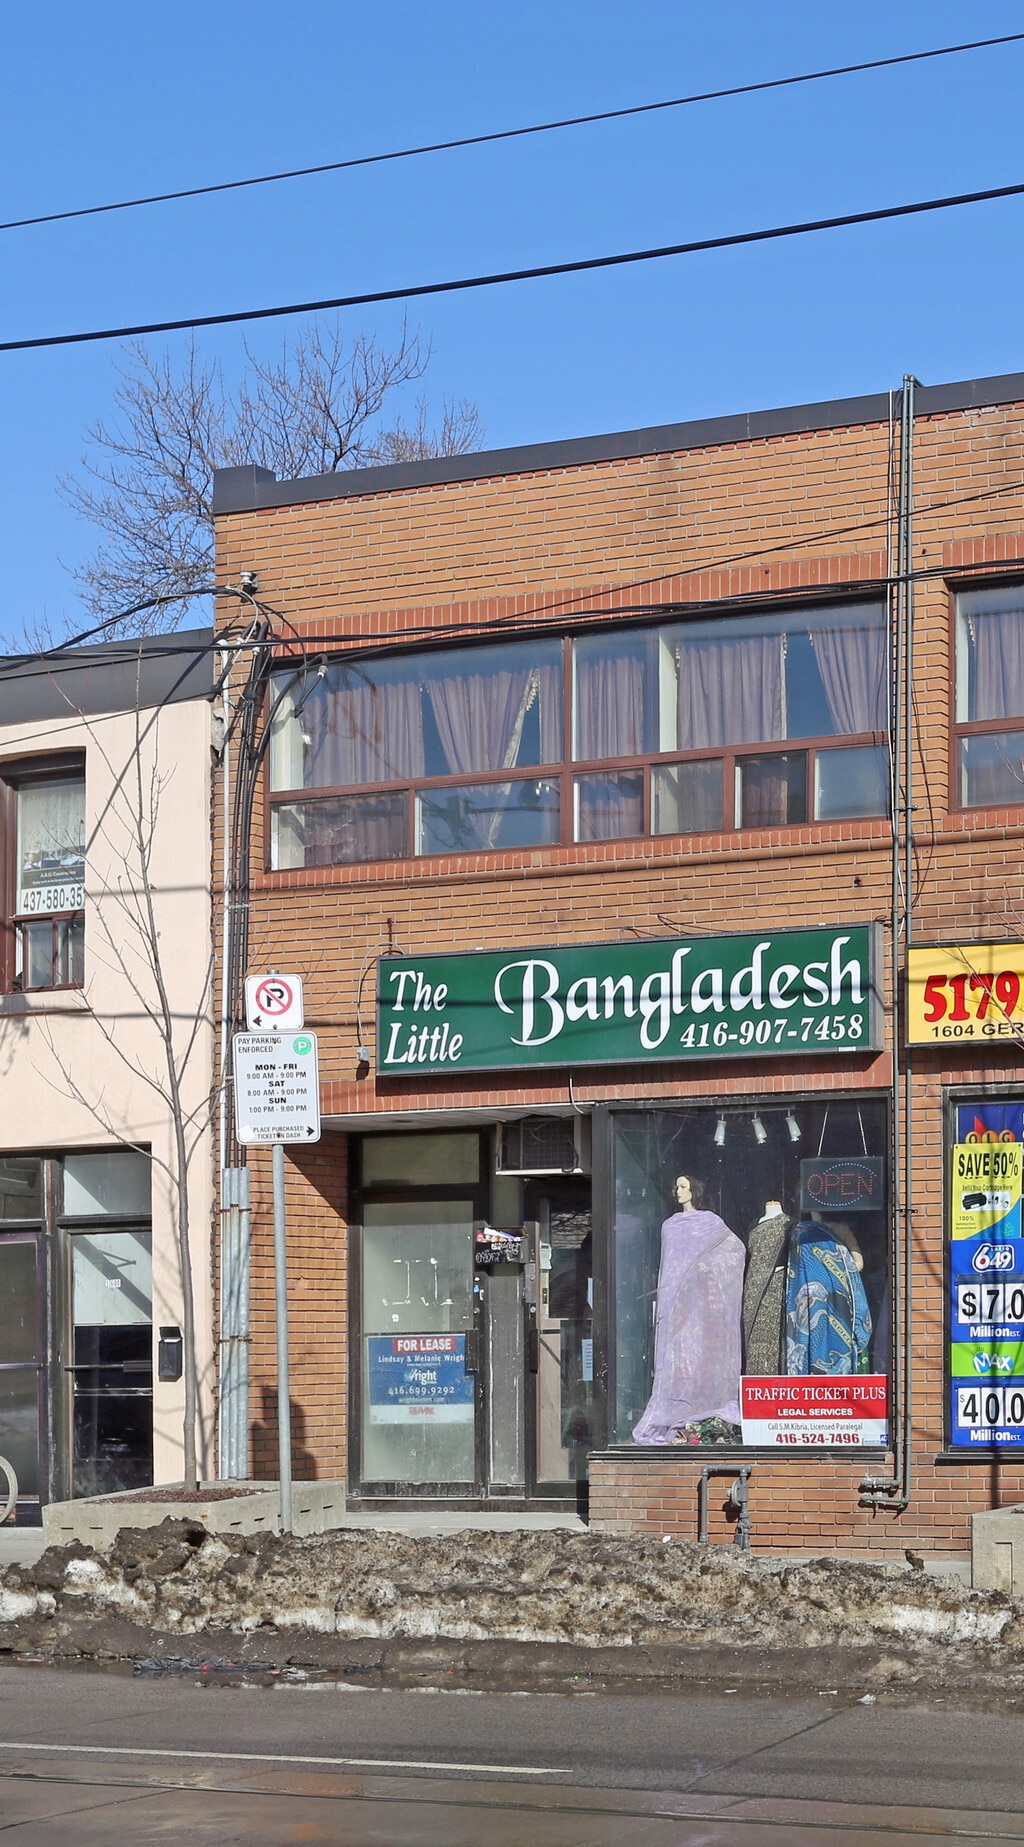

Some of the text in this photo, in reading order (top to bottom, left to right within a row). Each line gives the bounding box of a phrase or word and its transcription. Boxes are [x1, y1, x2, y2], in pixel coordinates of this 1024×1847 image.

[389, 968, 448, 1013] The
[494, 936, 866, 1050] Bangladesh
[923, 970, 1020, 1023] 5179
[680, 1013, 864, 1049] 416-907-7458
[931, 1023, 975, 1038] 1604
[251, 1036, 282, 1045] PARKING
[383, 1022, 464, 1065] Little
[238, 1045, 273, 1054] ENFORCED
[958, 1152, 1019, 1177] SAVE 50%
[807, 1173, 873, 1195] OPEN
[969, 1326, 1010, 1338] Million
[397, 1339, 451, 1351] FOR LEASE
[378, 1356, 404, 1364] Lindsay
[388, 1386, 455, 1396] 416.699.9292
[746, 1386, 886, 1401] TRAFFIC TICKET PLUS
[809, 1408, 853, 1416] SERVICES
[768, 1423, 778, 1431] Call
[810, 1423, 835, 1431] Licensed
[836, 1422, 863, 1432] Paralegal
[775, 1433, 860, 1444] 416-524-7496
[970, 1429, 1011, 1441] Million
